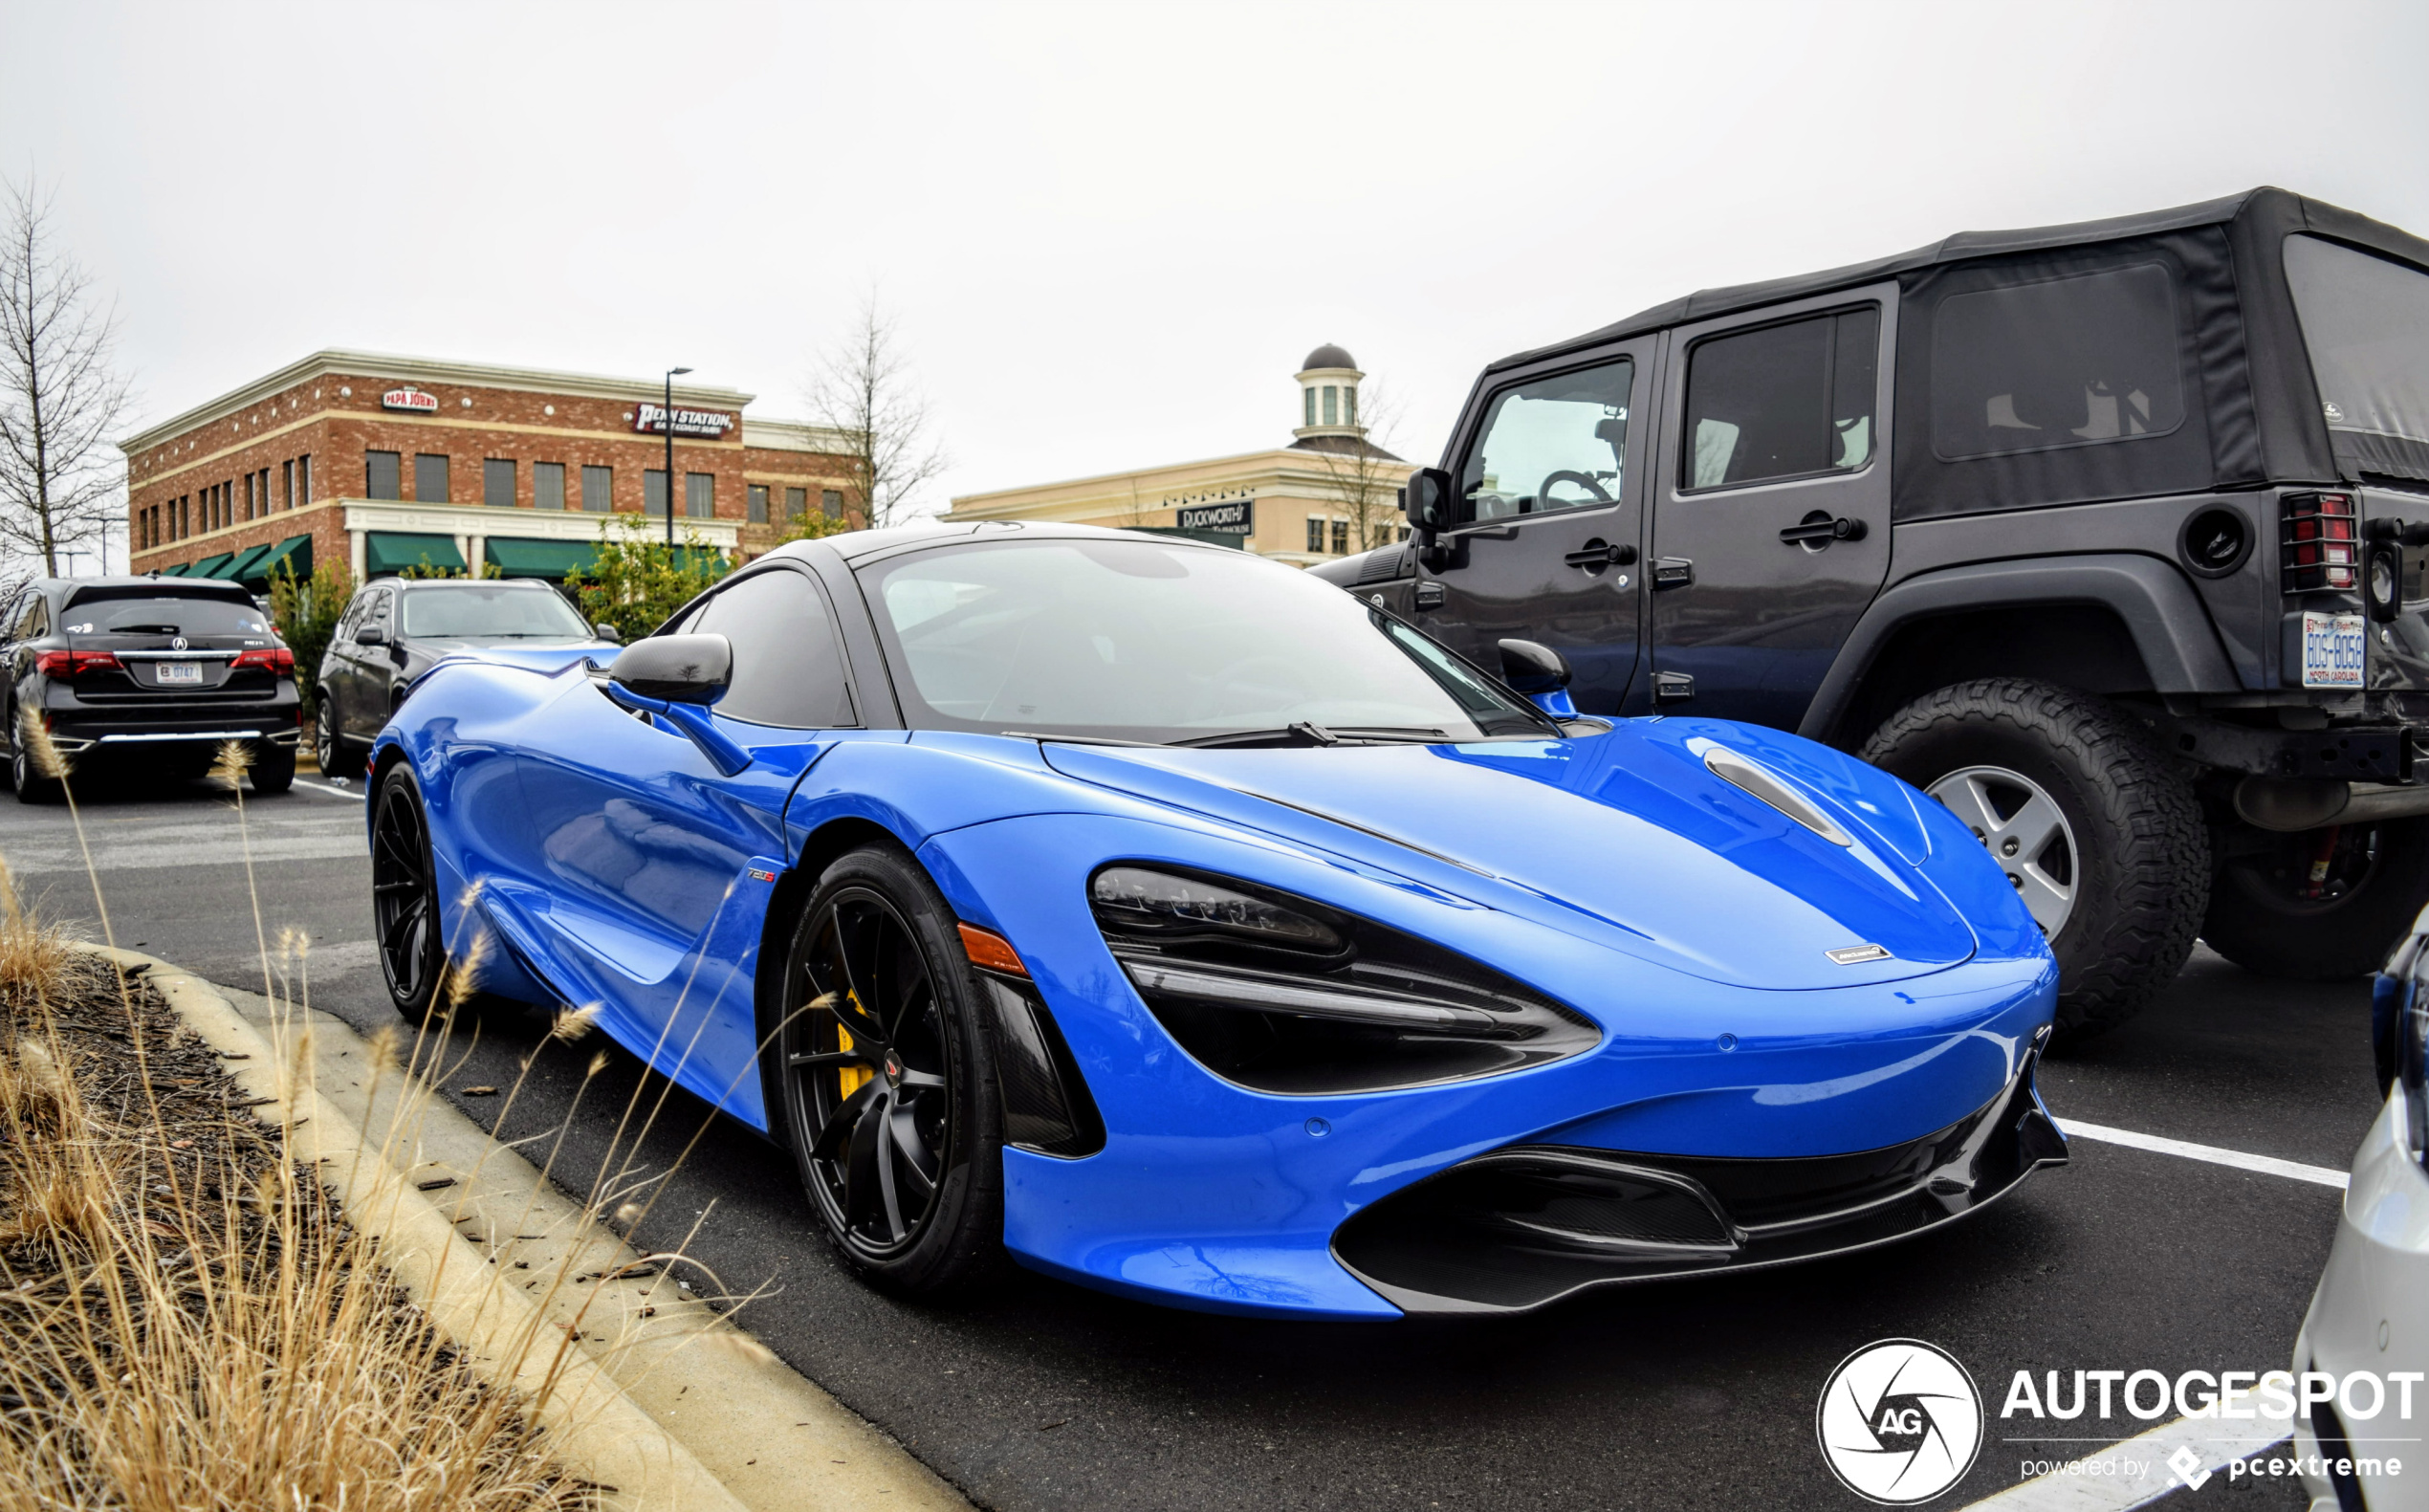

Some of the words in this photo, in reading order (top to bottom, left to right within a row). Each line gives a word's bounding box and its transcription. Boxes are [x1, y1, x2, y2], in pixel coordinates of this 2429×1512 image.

[386, 392, 407, 405] PAPA
[678, 410, 731, 427] STATION
[653, 422, 675, 430] EAT
[2331, 671, 2359, 682] CAROLINA
